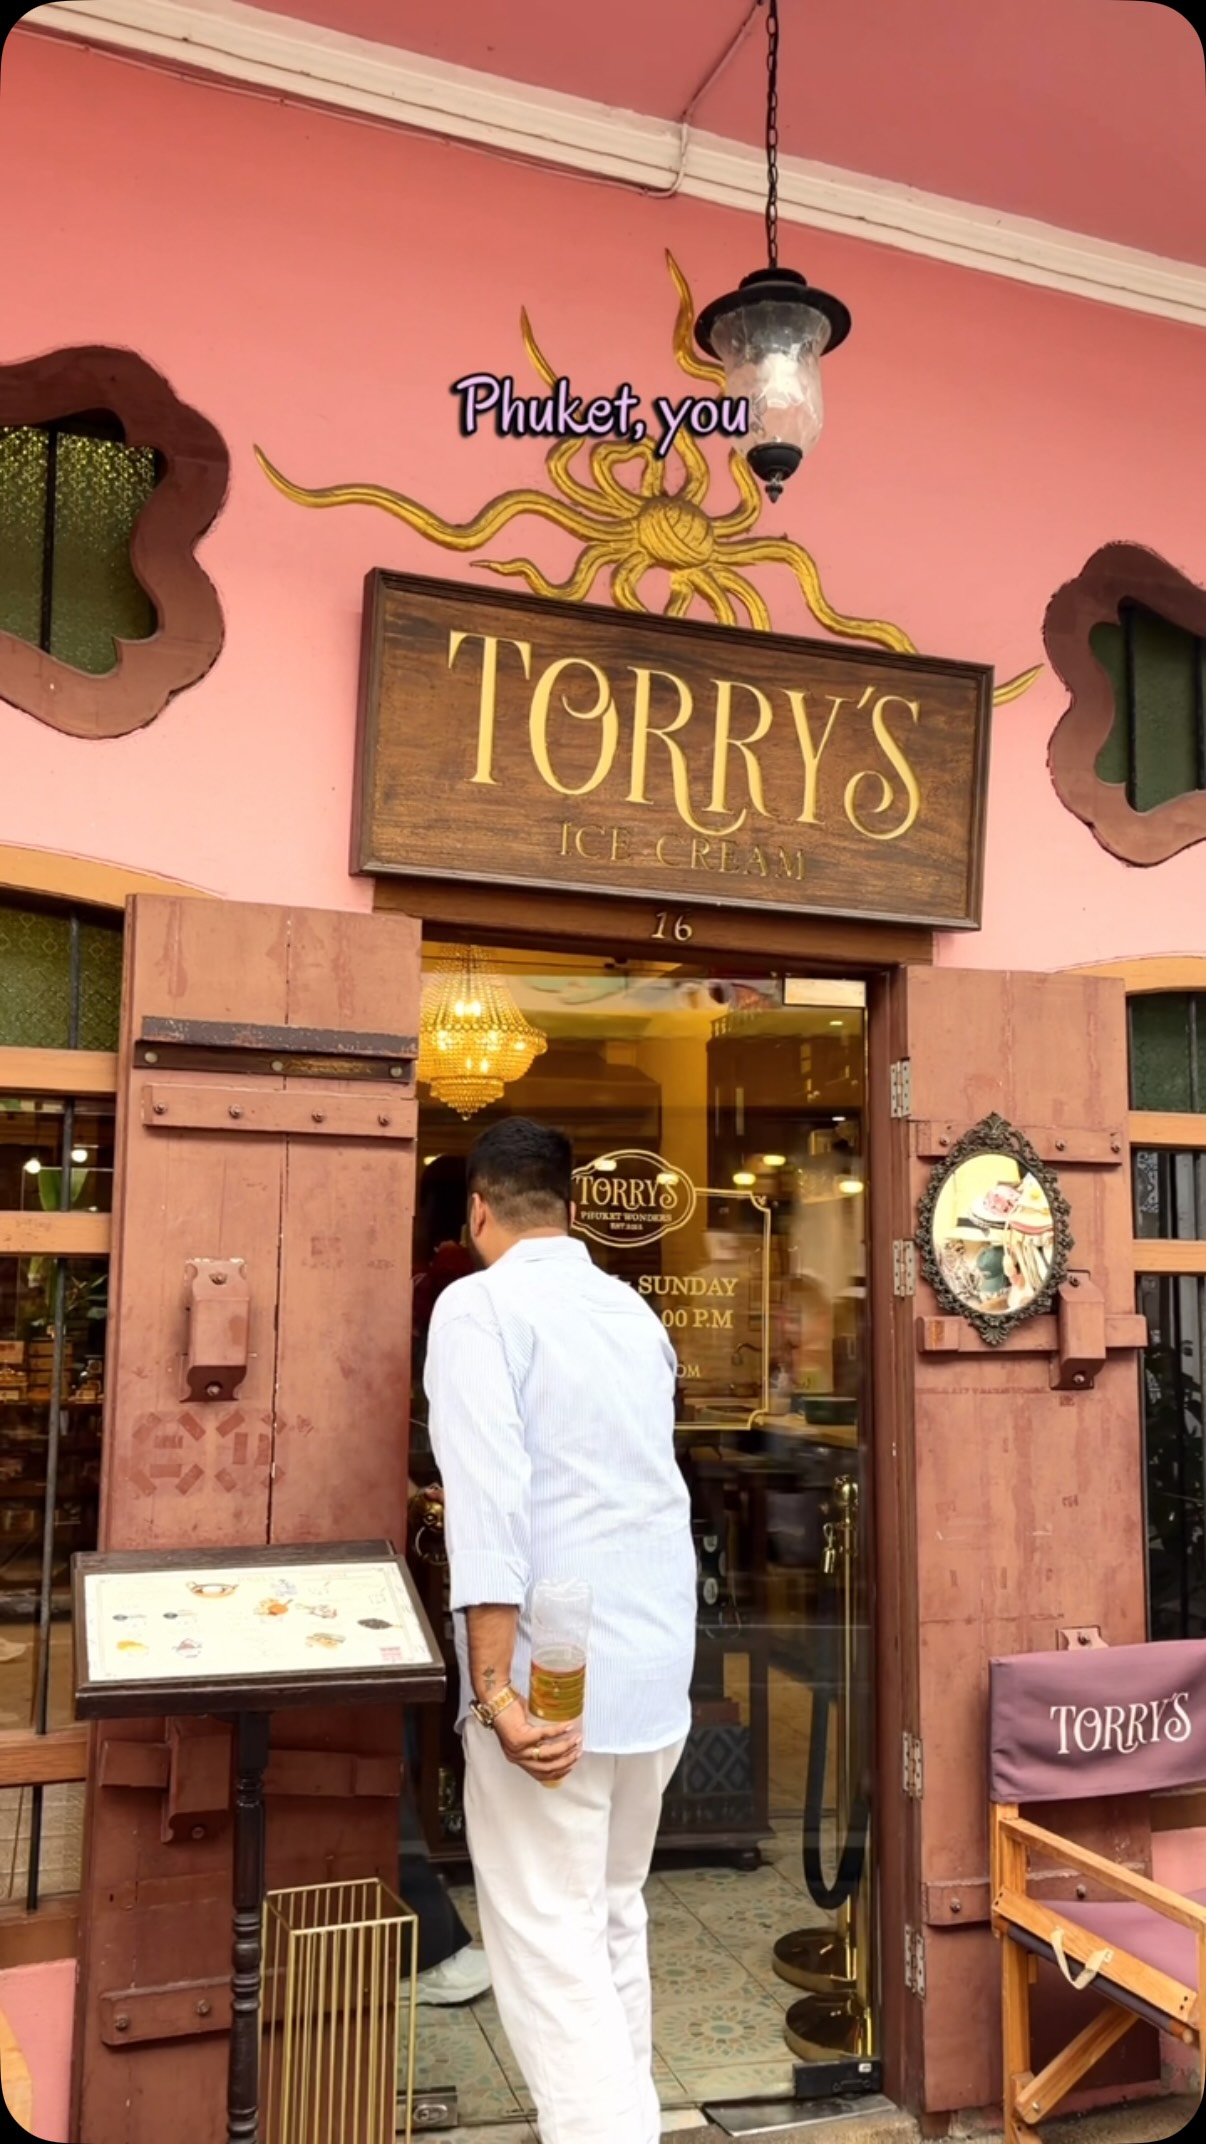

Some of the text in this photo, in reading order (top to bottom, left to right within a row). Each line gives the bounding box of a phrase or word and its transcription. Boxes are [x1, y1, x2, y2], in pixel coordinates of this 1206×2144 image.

[448, 630, 922, 840] TORRY'S
[560, 820, 806, 880] ICE CREAM
[651, 911, 692, 941] 16
[638, 1275, 739, 1296] SUNDAY
[692, 1309, 734, 1328] P.M
[1050, 1692, 1191, 1754] TORRY'S
